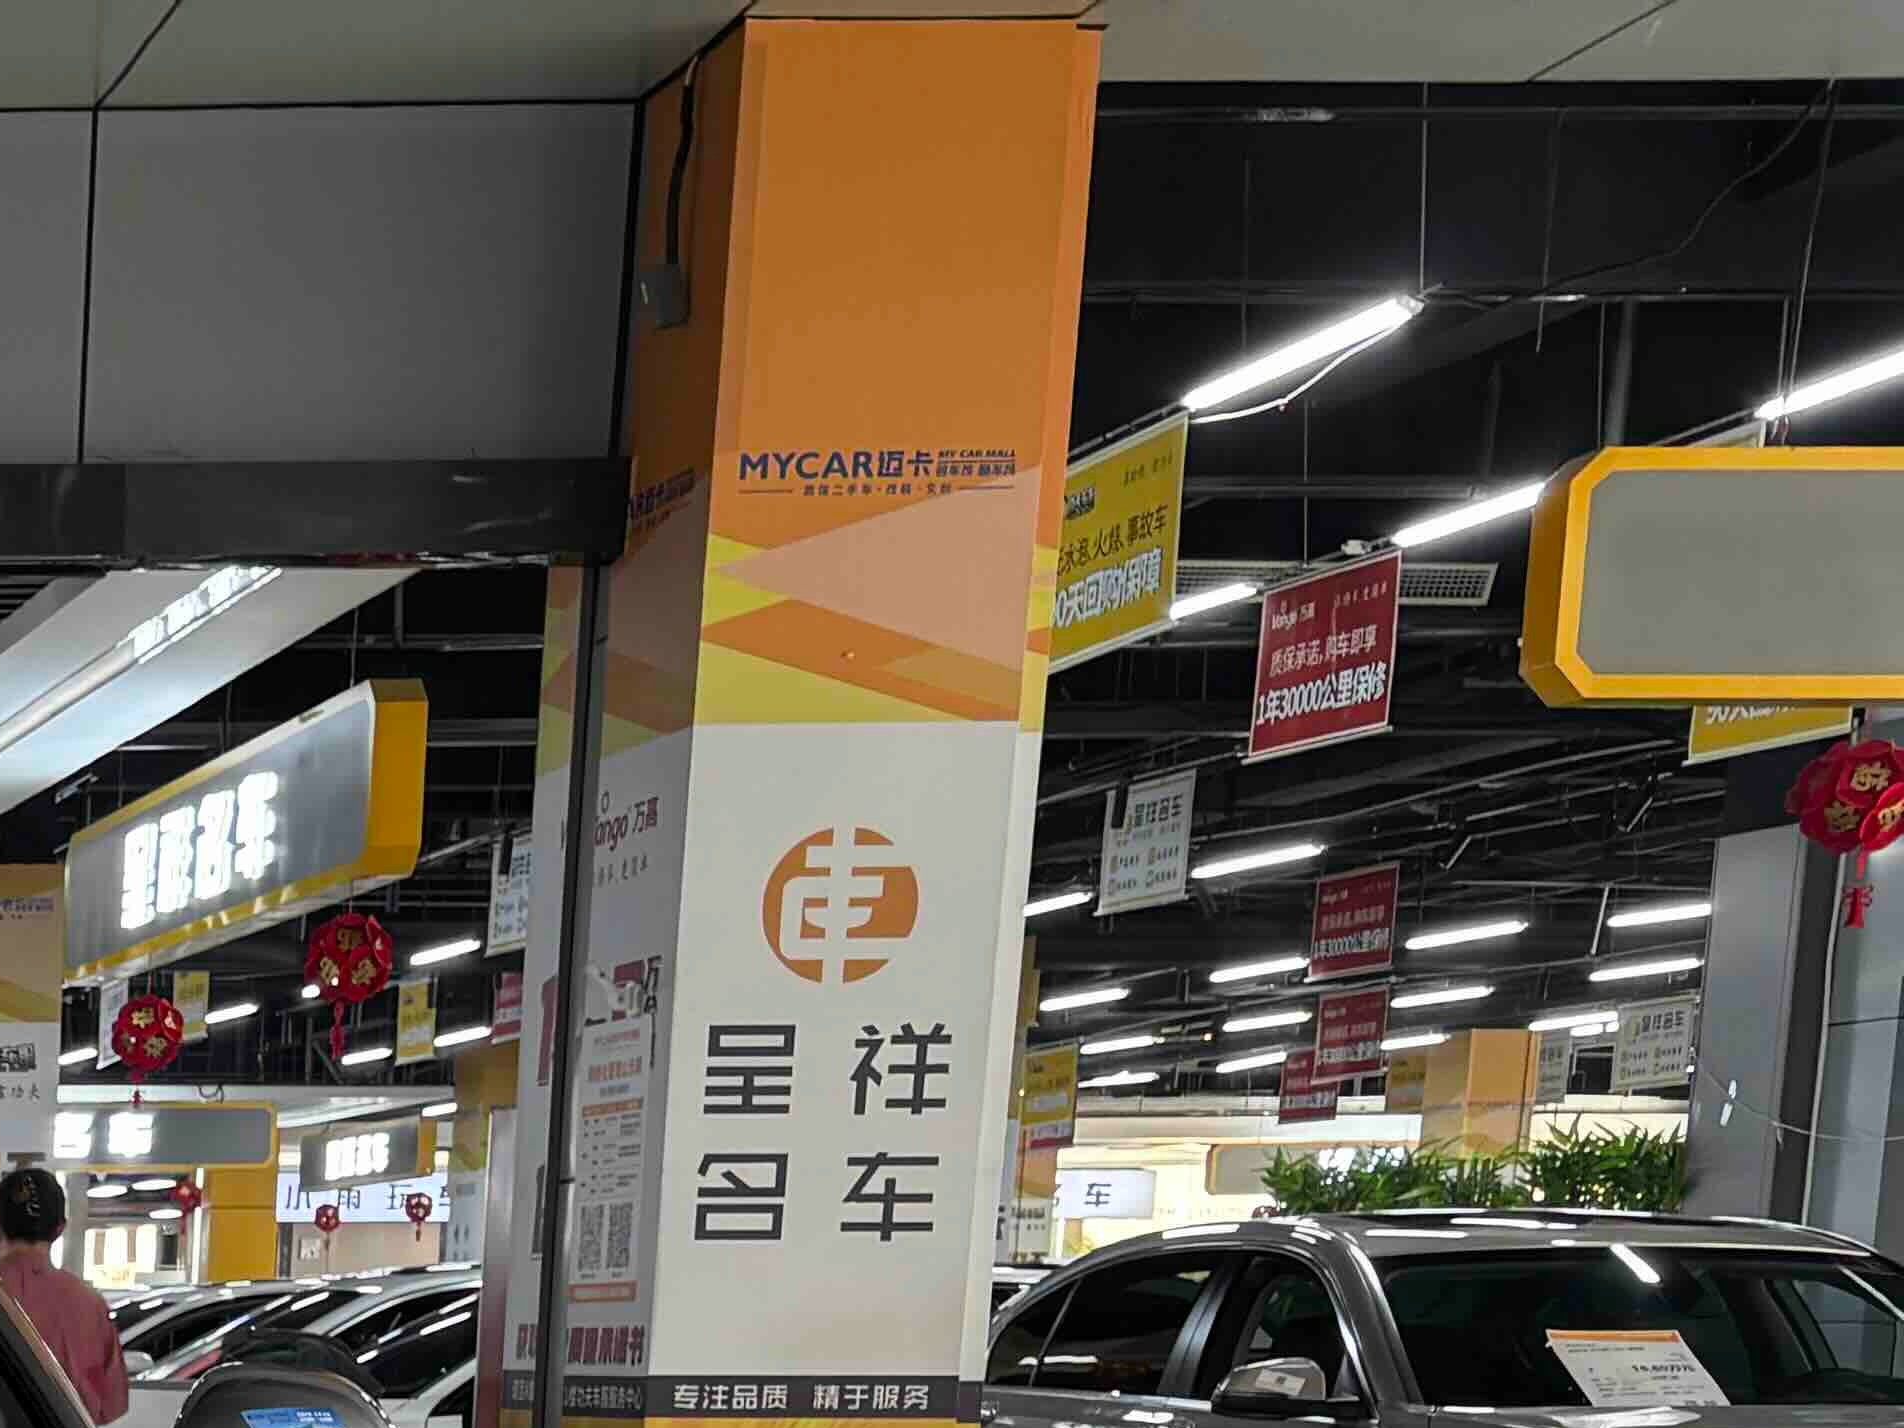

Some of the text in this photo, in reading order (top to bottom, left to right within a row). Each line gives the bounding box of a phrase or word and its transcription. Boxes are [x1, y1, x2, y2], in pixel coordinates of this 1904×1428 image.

[1053, 546, 1164, 630] 0天回购保障
[1256, 661, 1387, 726] 1年30000公里保修
[703, 1022, 953, 1116] 呈祥
[694, 1151, 942, 1243] 名车
[672, 1383, 789, 1412] 专注品质
[812, 1384, 930, 1412] 精于服务
